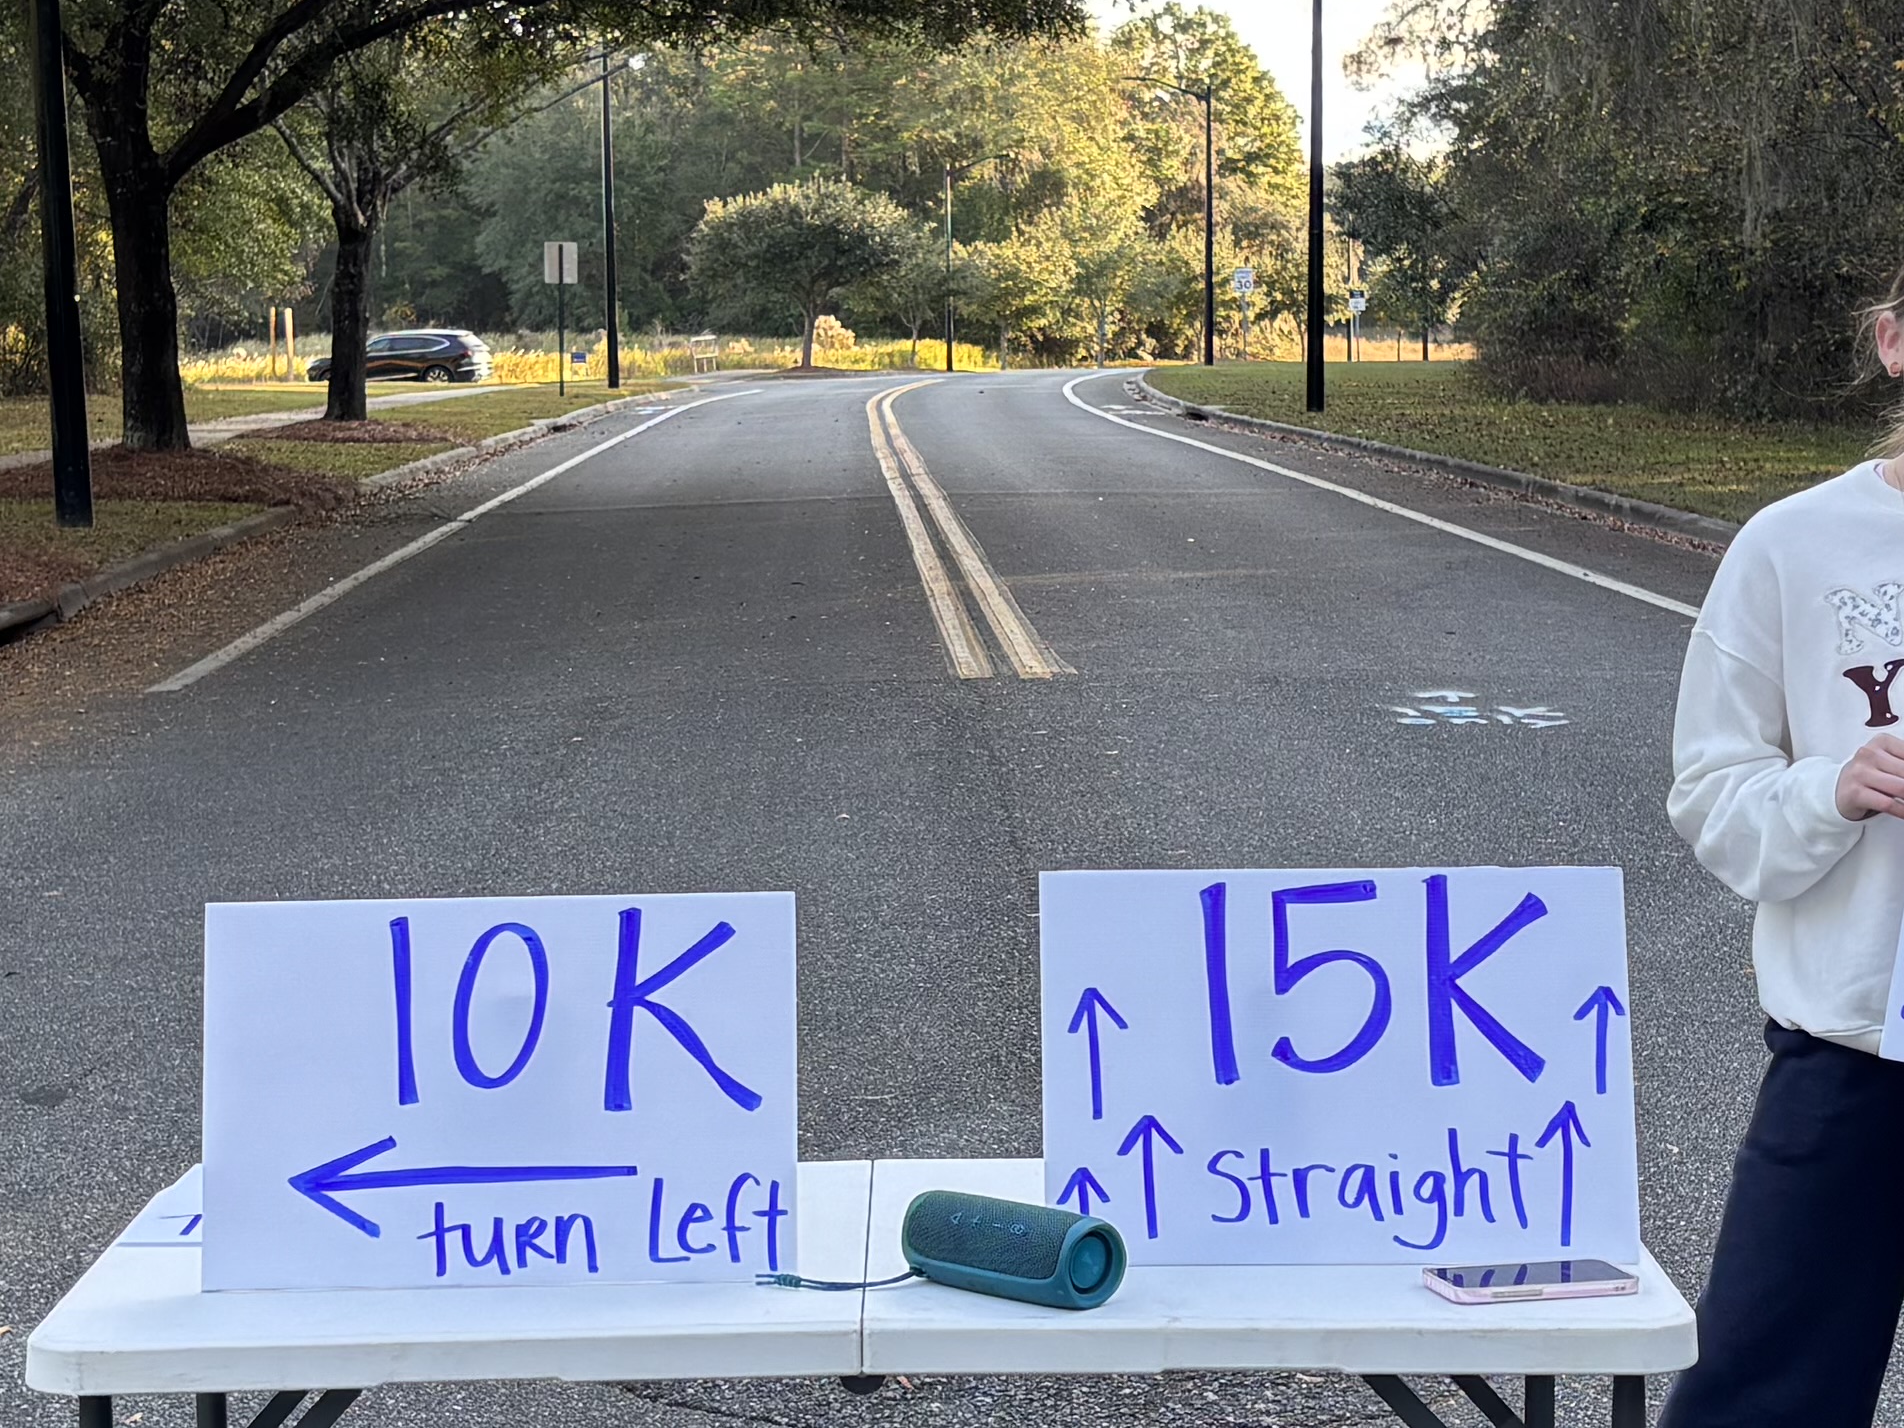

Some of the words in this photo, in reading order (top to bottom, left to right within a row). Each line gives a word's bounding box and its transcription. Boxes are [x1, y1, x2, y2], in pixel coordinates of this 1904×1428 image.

[1236, 280, 1252, 290] 30
[389, 907, 764, 1113] 10K
[1199, 873, 1550, 1088] 15K
[648, 1172, 789, 1273] Left
